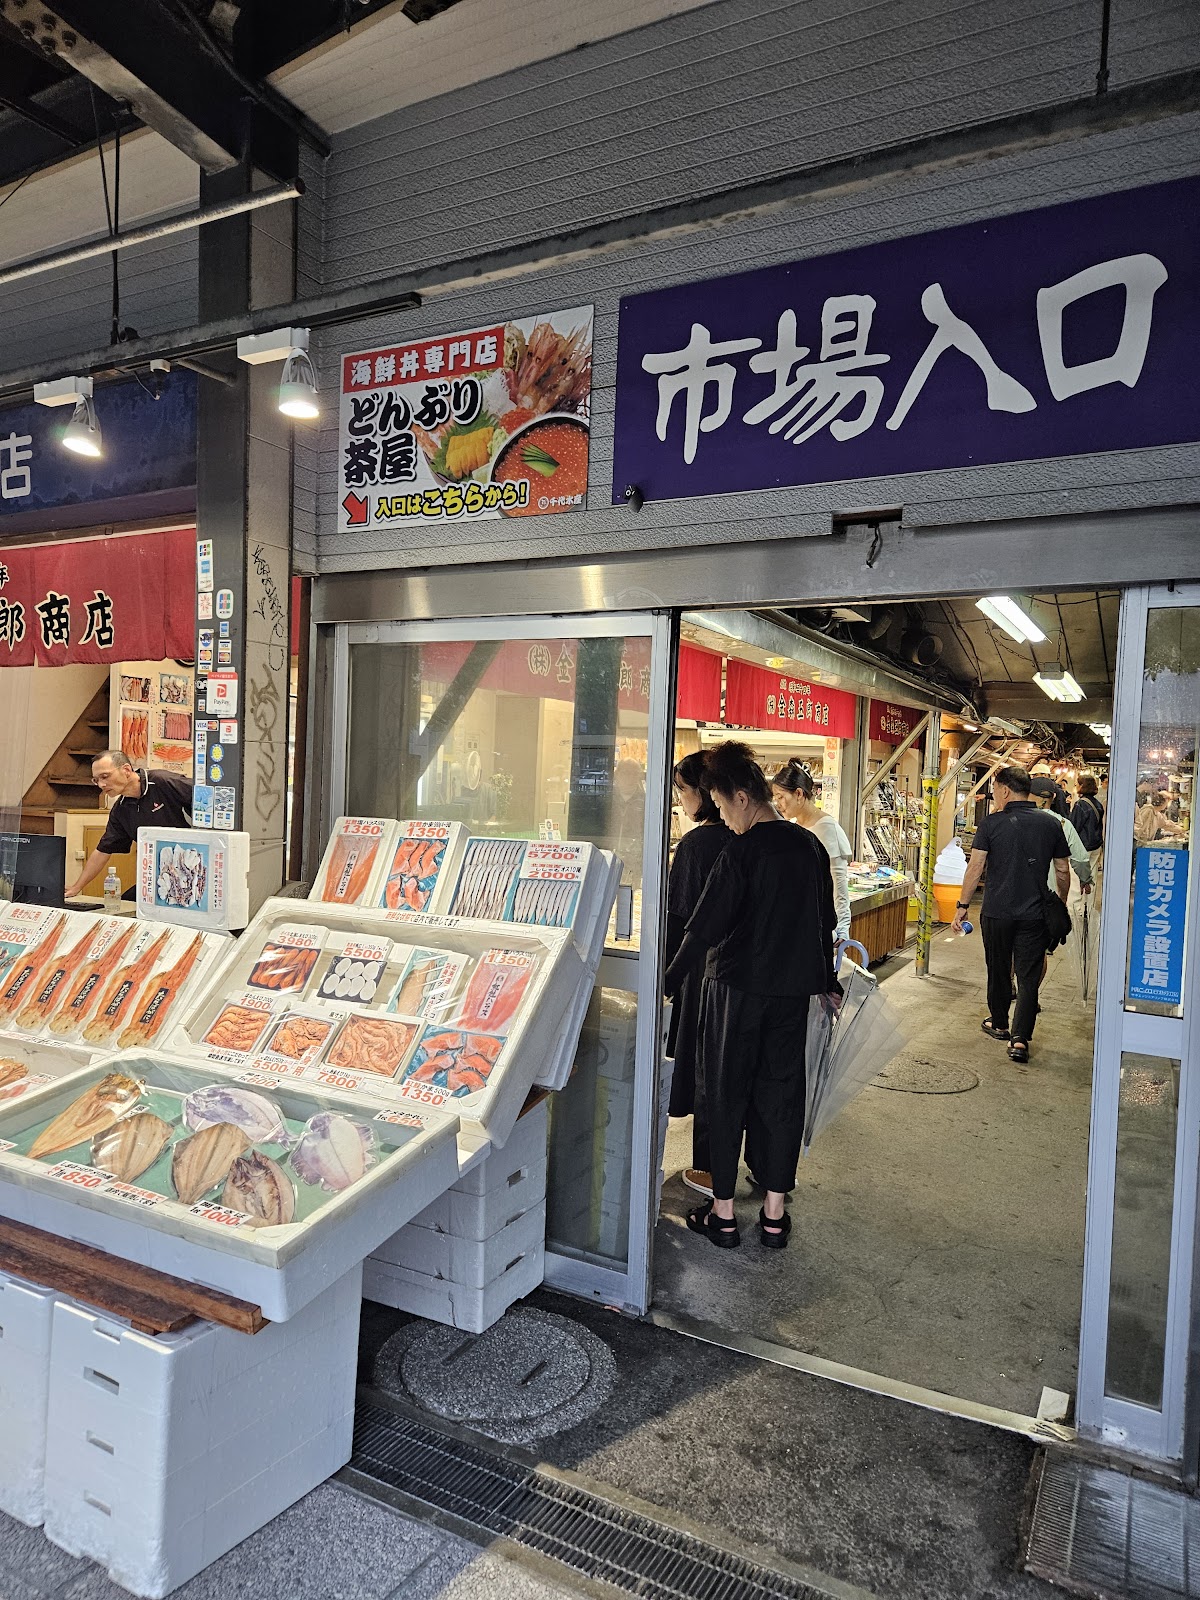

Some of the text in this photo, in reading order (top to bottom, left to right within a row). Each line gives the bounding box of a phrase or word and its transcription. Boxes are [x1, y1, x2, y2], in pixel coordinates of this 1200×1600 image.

[350, 335, 498, 386] 海鮮丼専門店
[641, 252, 1169, 465] 市場入口
[347, 375, 485, 438] どんぶり
[343, 430, 417, 486] 茶屋
[1, 836, 31, 844] PRINCETON
[1141, 851, 1177, 988] 防犯カメラ設置店
